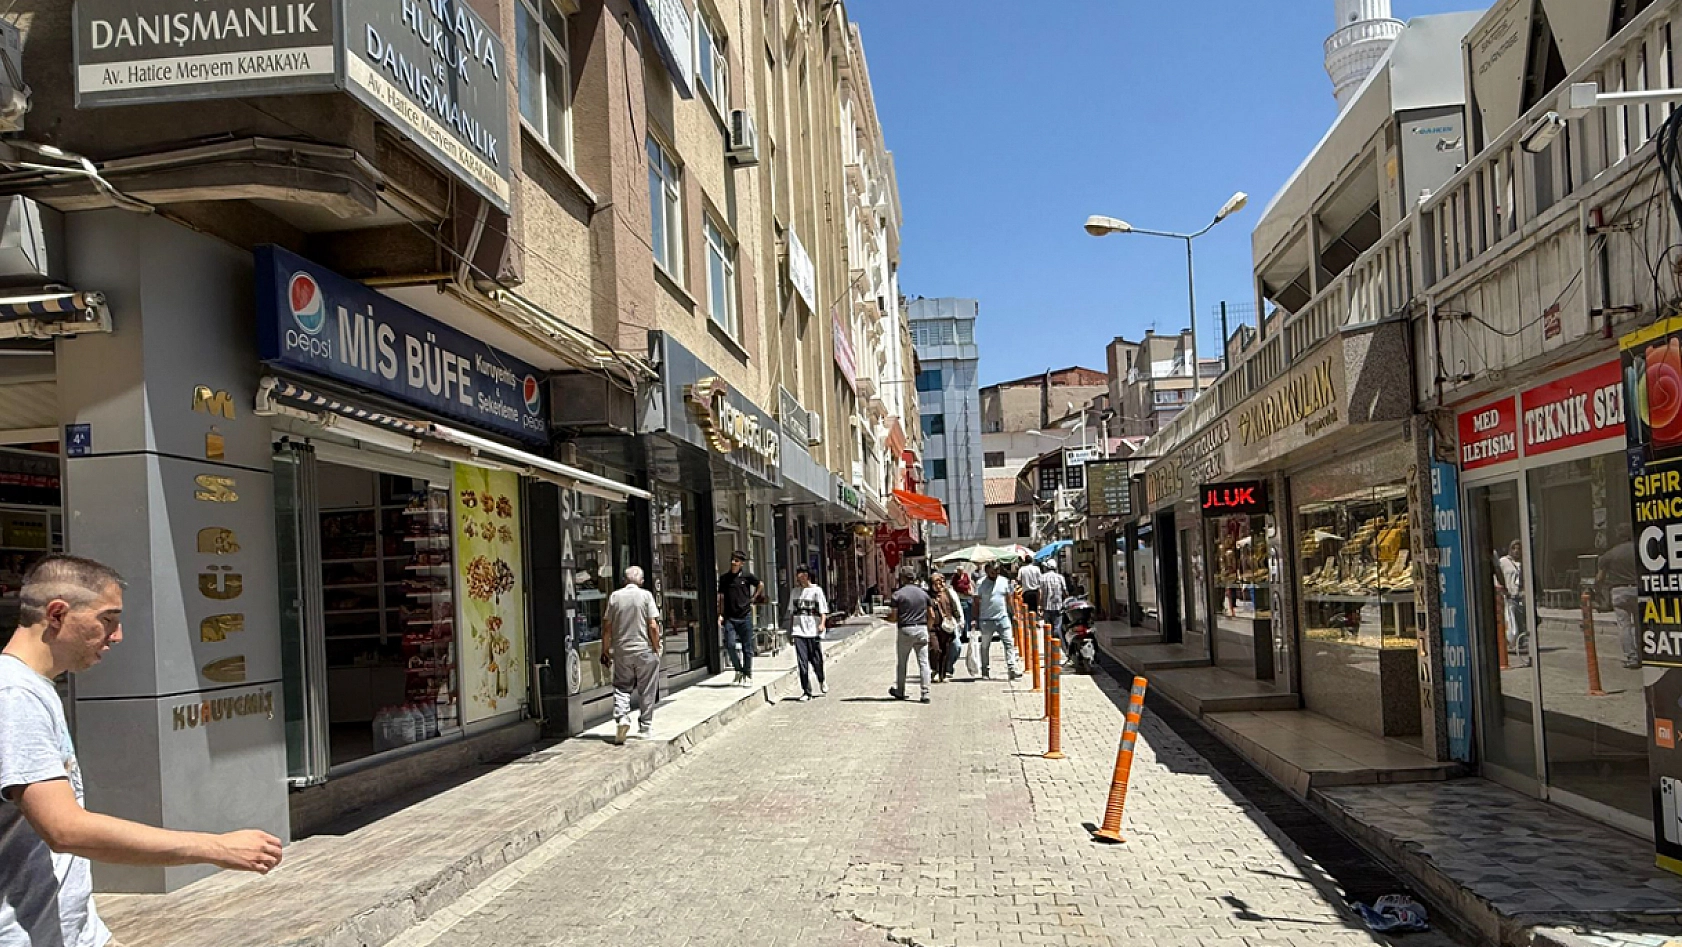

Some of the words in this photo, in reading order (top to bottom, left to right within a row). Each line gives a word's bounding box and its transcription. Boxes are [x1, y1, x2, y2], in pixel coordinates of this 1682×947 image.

[91, 3, 318, 49] DANIŞMANLIK
[402, 0, 469, 86] HUKUK
[102, 68, 124, 85] Av.
[128, 63, 172, 83] Hatice
[176, 61, 233, 85] Meryem
[238, 52, 310, 75] KARAKAYA
[430, 57, 445, 86] VE
[365, 22, 499, 168] DANIŞMANLIK
[367, 71, 385, 99] Av.
[386, 85, 420, 126] Hatice
[285, 329, 333, 360] pepsi
[337, 304, 398, 381] MİS
[405, 332, 474, 407] BÜFE
[1250, 356, 1336, 444] KARAKULAK
[1473, 409, 1500, 433] MED
[1525, 388, 1591, 446] TEKNİK
[1462, 431, 1516, 461] İLETİŞİM
[1635, 470, 1681, 497] SIFIR
[1642, 574, 1682, 592] TELE
[1643, 630, 1682, 656] SAT
